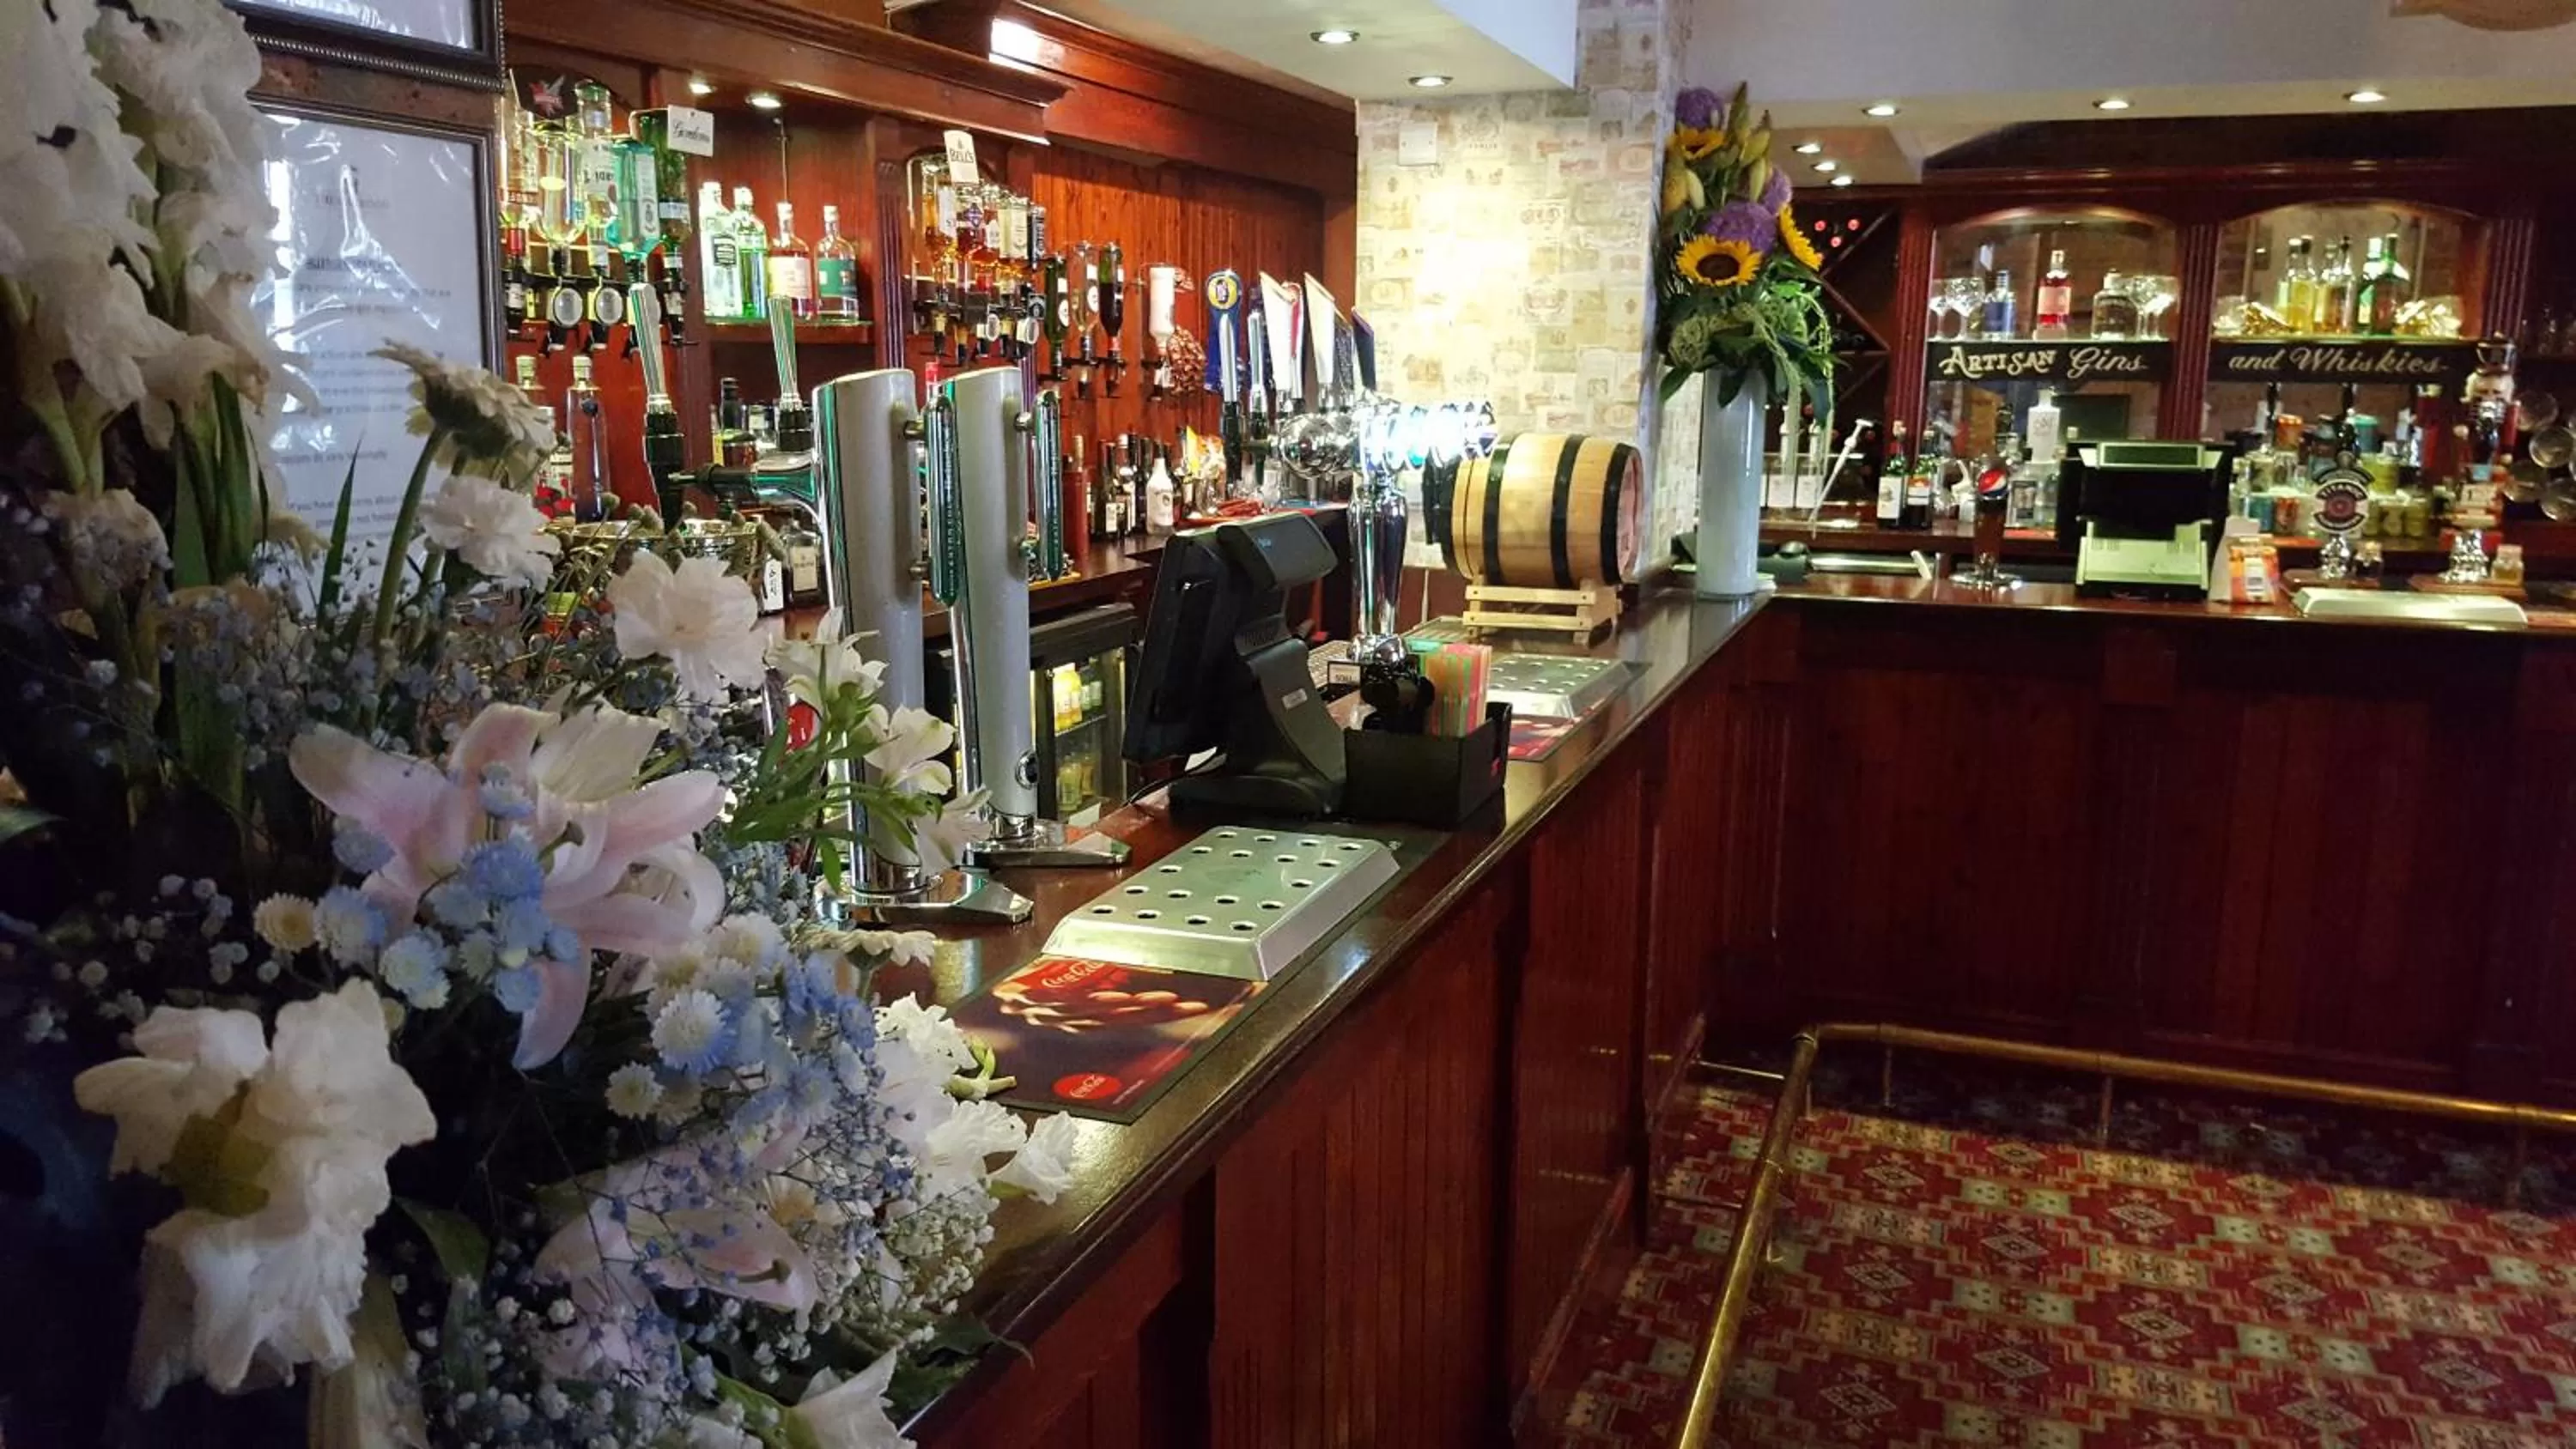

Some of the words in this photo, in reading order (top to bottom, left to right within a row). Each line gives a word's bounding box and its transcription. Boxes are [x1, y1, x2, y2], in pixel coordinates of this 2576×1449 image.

[1938, 346, 2057, 379] ARTISAN
[2067, 347, 2148, 379] Gins
[2228, 349, 2286, 370] and
[2289, 347, 2446, 373] Whiskies
